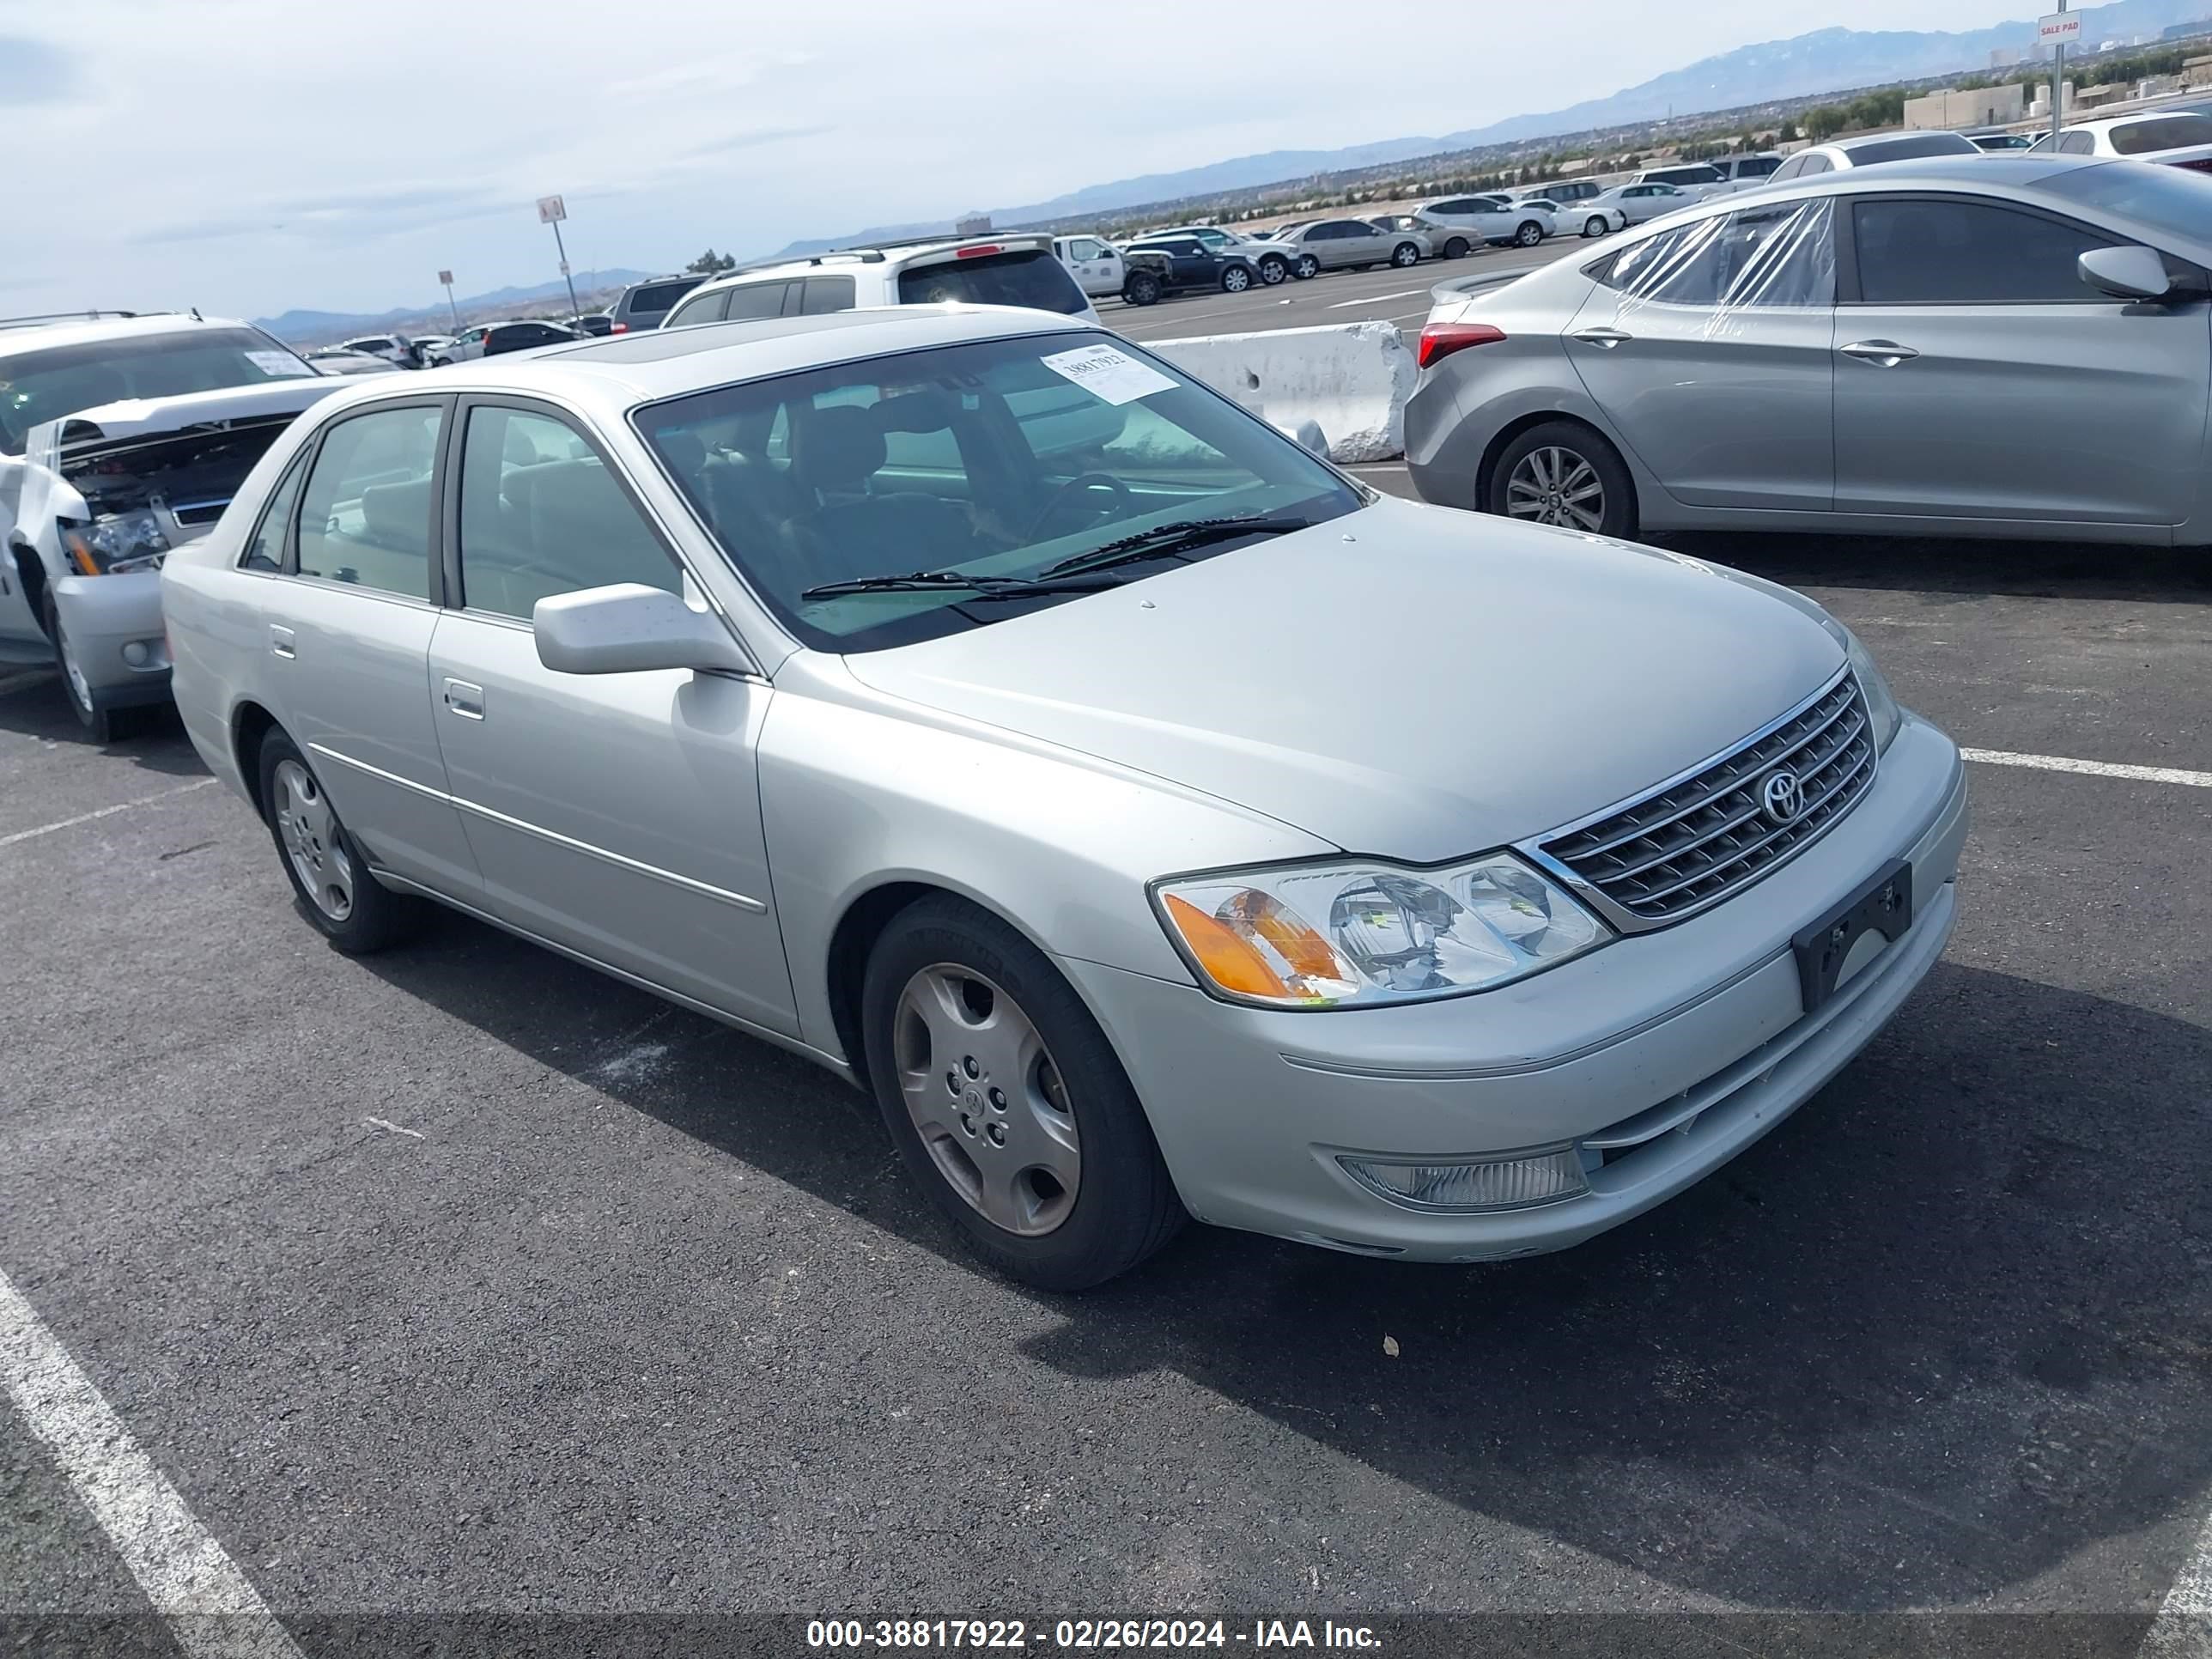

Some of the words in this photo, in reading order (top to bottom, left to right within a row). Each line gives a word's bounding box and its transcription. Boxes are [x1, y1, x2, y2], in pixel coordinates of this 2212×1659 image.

[2041, 26, 2060, 35] SALE
[2063, 22, 2078, 31] PAD
[1064, 355, 1126, 375] 38817922
